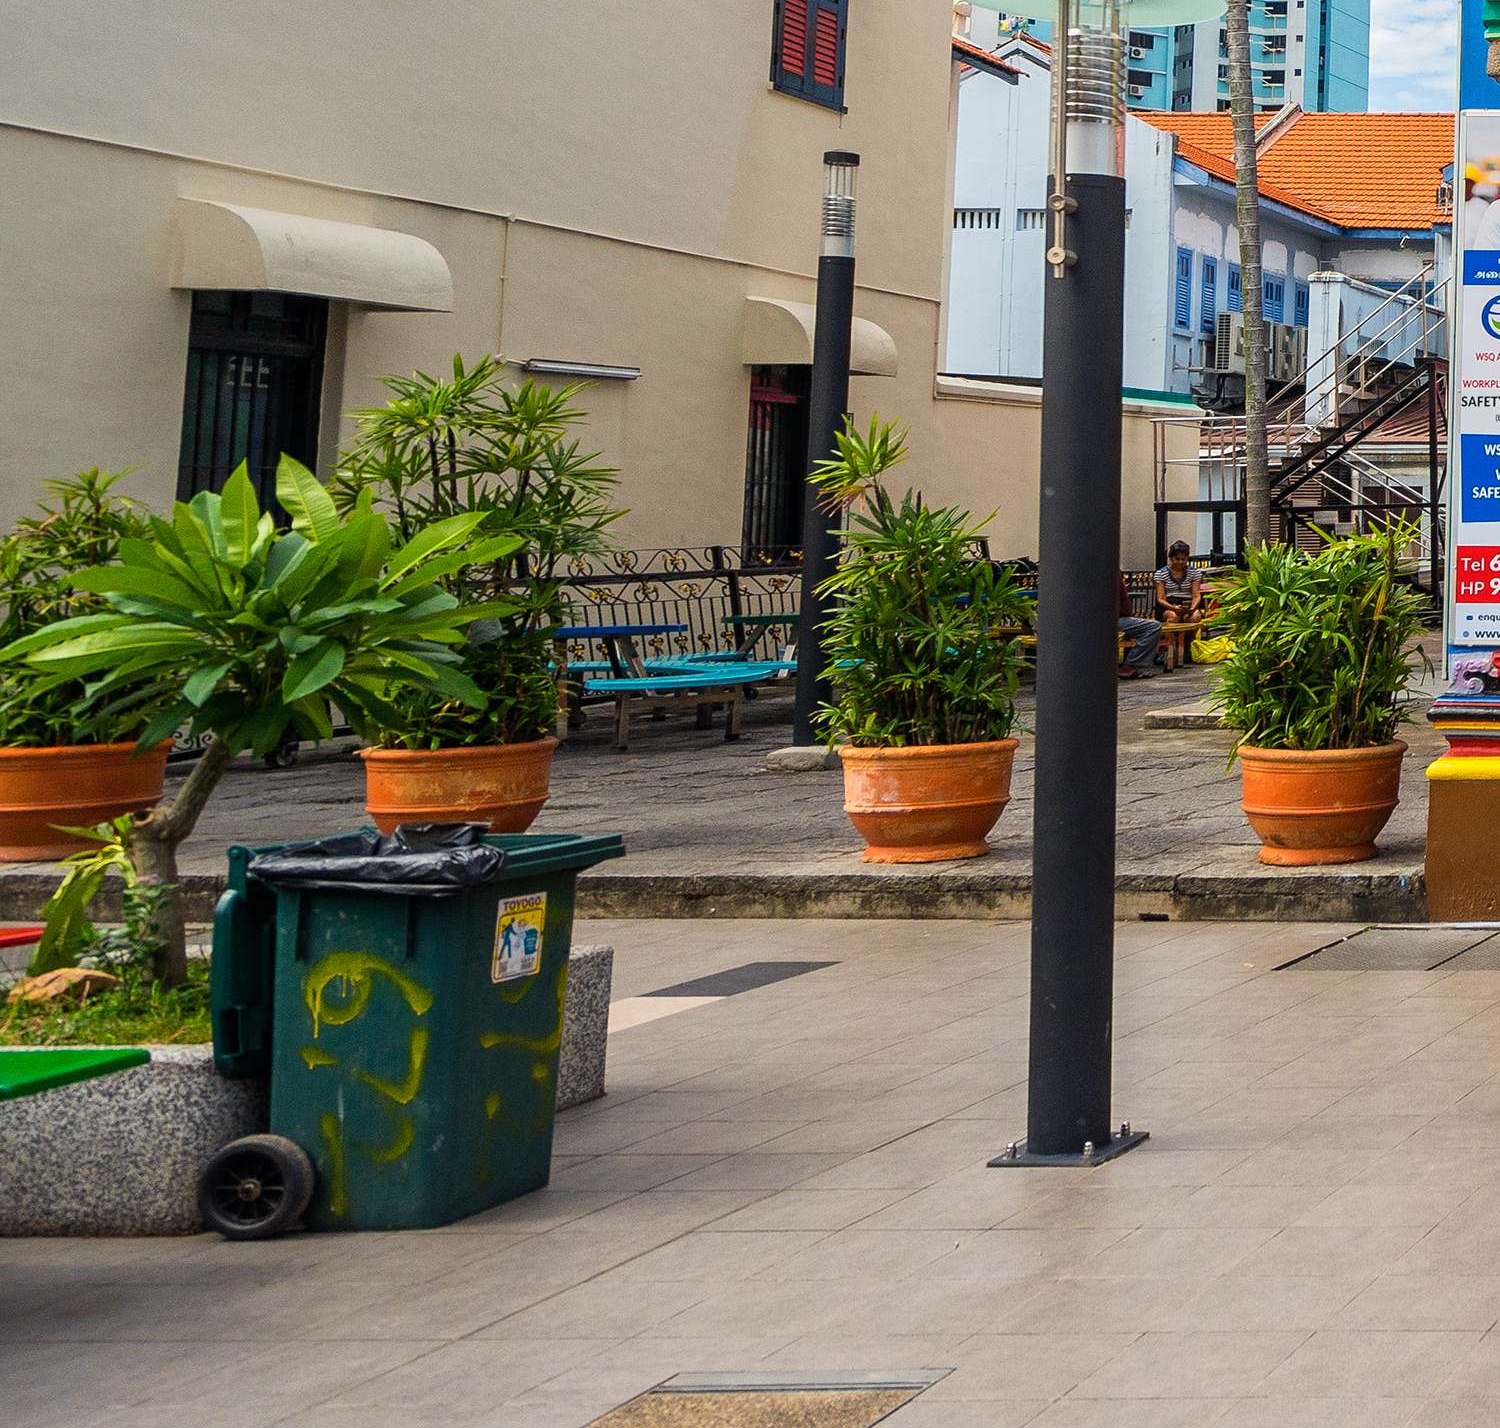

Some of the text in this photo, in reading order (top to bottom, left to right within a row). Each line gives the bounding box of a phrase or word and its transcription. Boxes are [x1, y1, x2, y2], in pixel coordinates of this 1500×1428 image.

[1461, 557, 1485, 572] Tel
[1461, 581, 1485, 595] HP
[503, 896, 542, 911] TOYOGO
